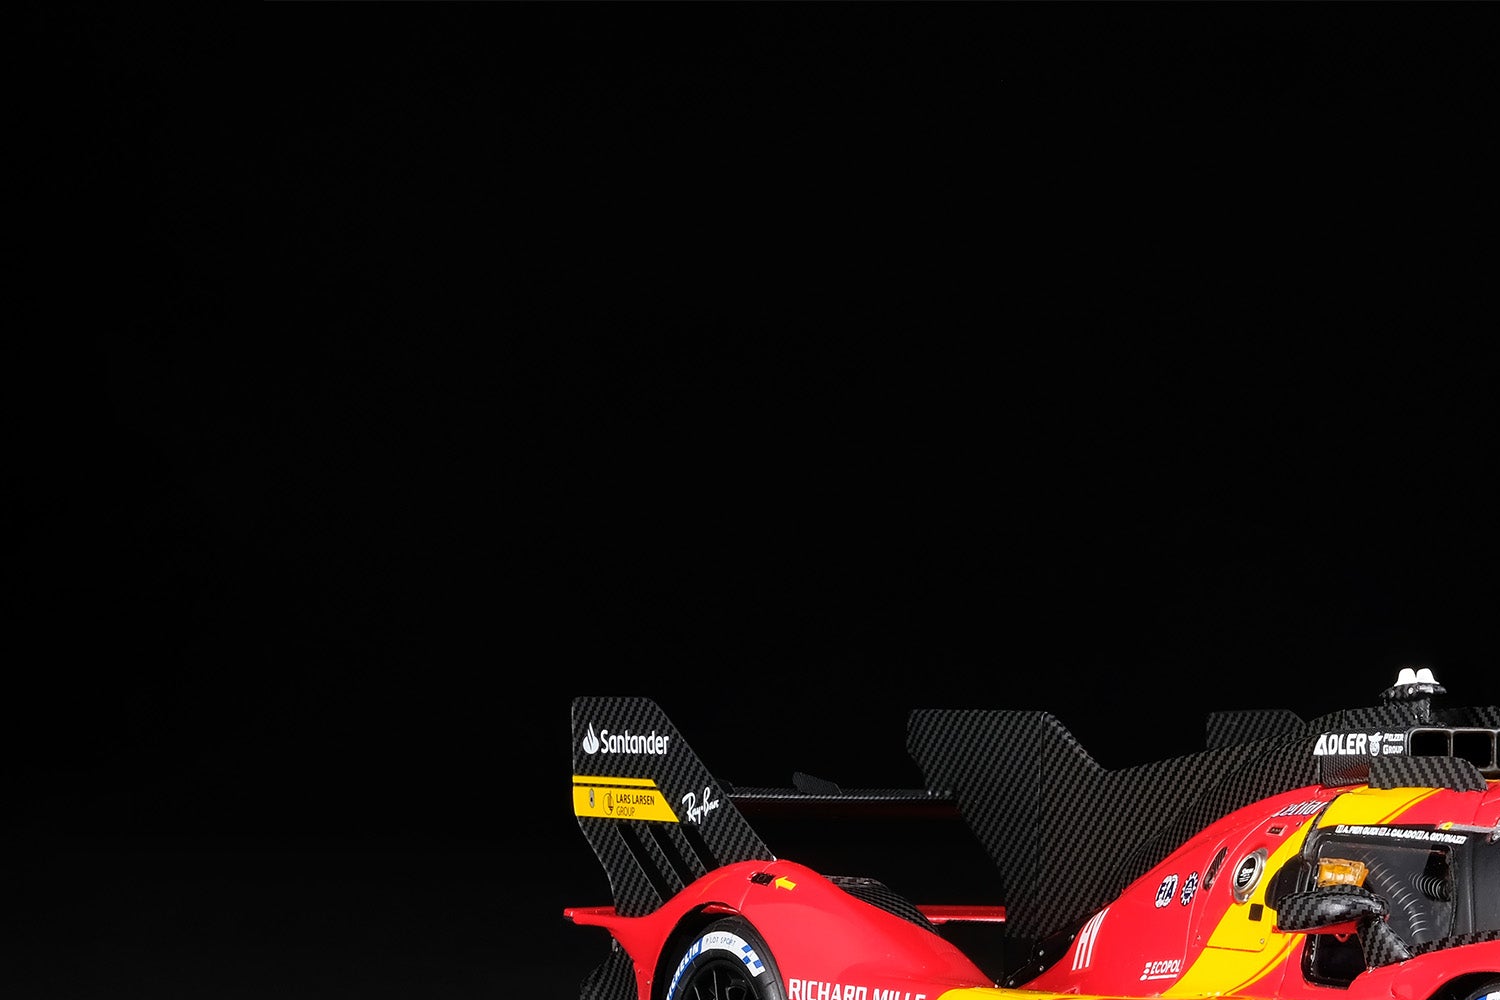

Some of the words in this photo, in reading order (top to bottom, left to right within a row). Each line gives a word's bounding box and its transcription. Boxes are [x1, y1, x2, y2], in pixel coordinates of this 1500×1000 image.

[601, 729, 669, 755] Santander
[1313, 733, 1367, 756] ADLER
[616, 794, 631, 804] LARS
[632, 795, 654, 806] LARSEN
[682, 786, 719, 824] Ray-Ban
[616, 806, 635, 816] GROUP
[1156, 880, 1176, 901] FIA
[1149, 960, 1181, 974] ECOPOL
